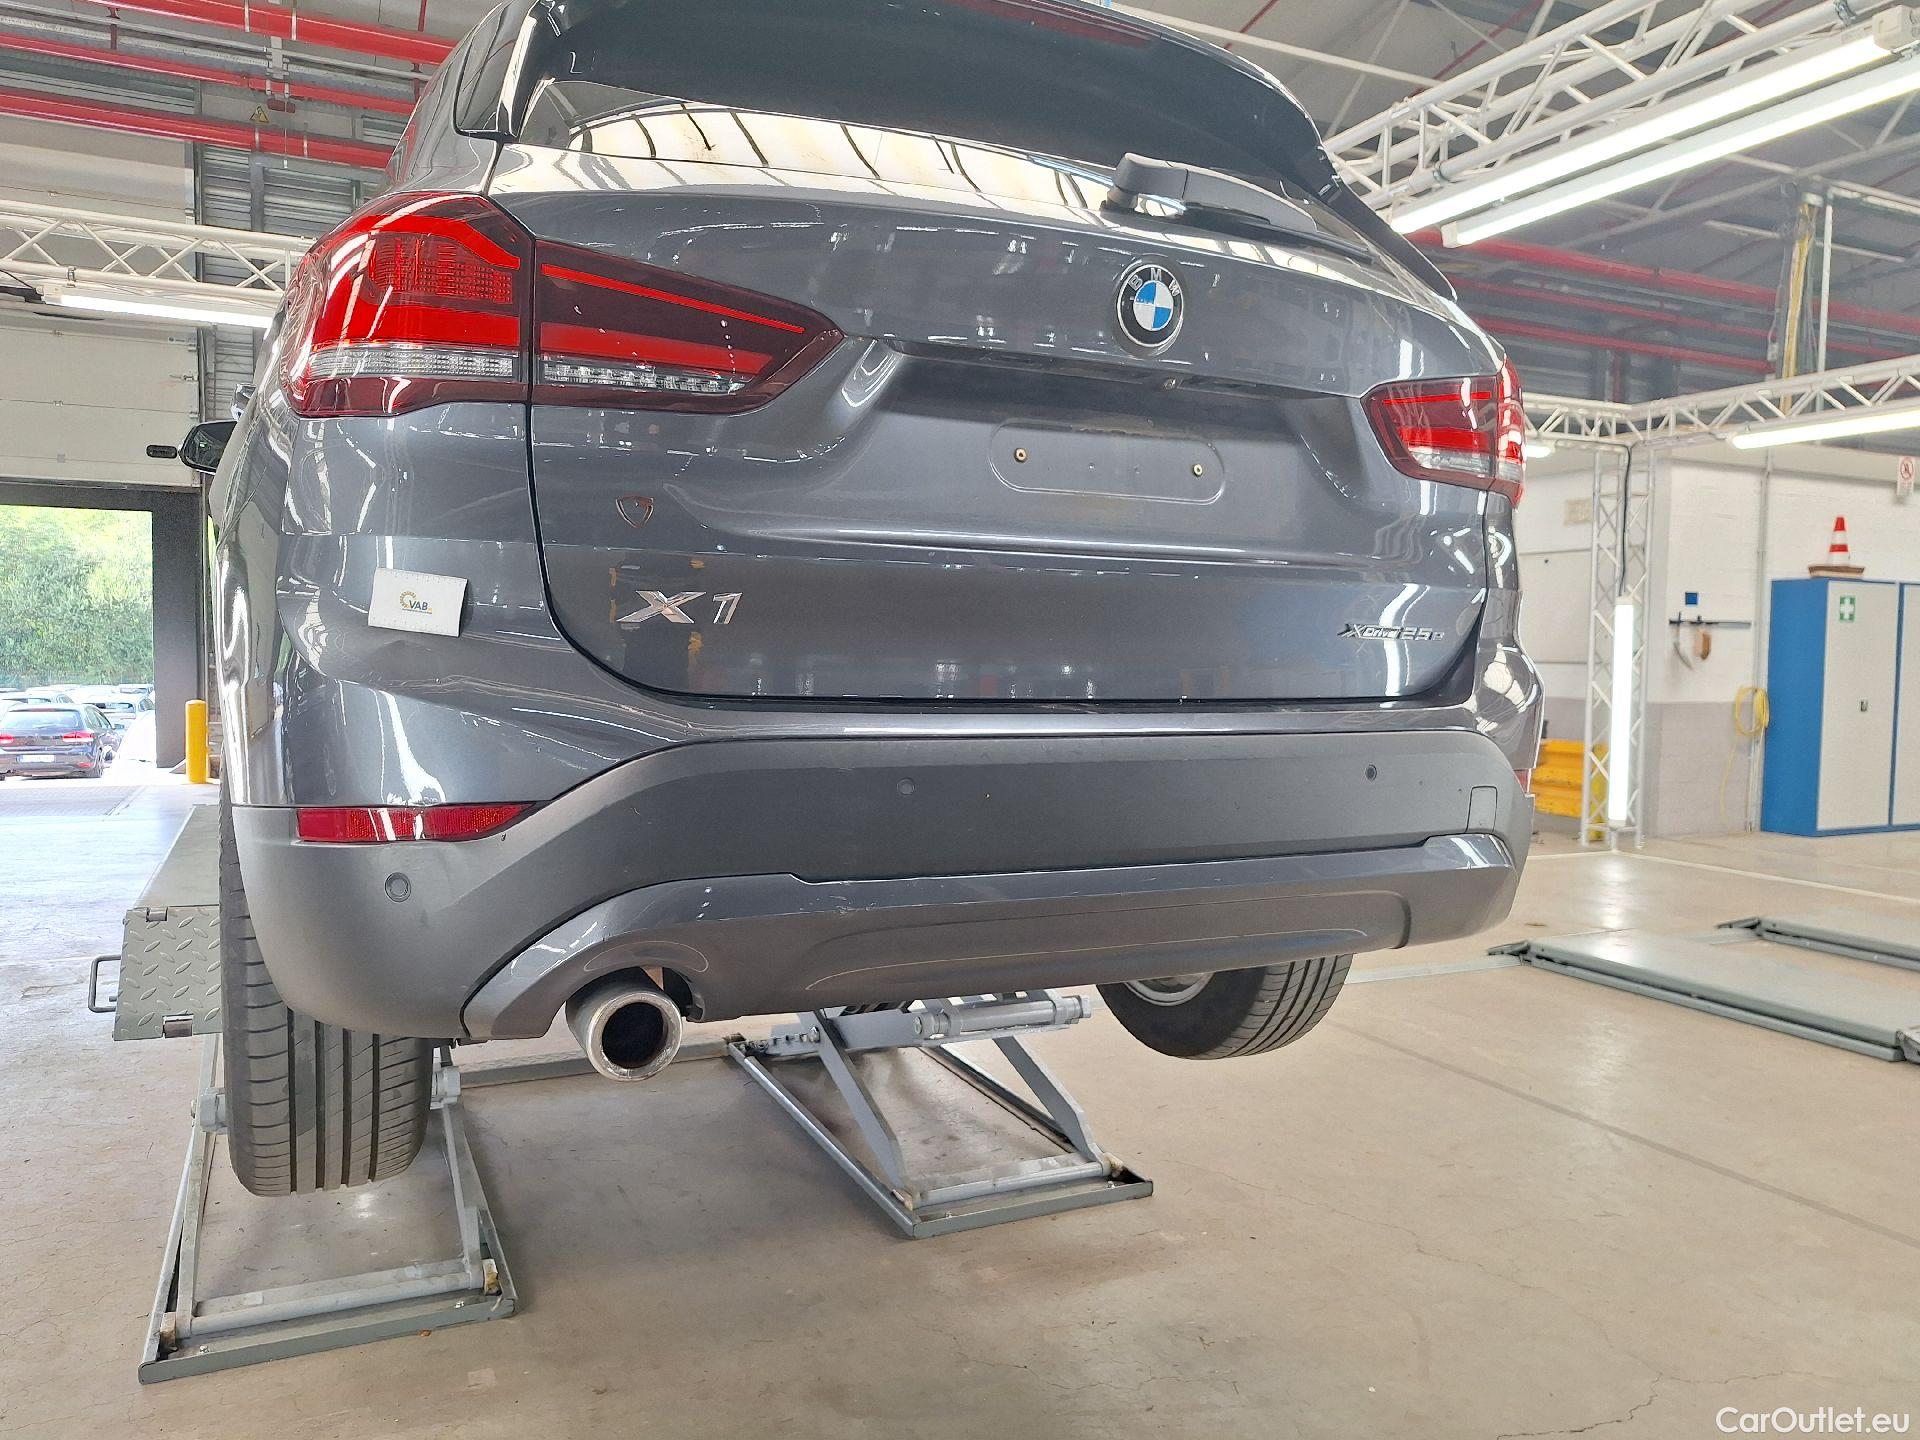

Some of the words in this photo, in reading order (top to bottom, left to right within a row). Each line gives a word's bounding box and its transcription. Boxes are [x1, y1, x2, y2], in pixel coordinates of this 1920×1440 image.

[1127, 267, 1181, 297] BMW
[408, 599, 429, 611] VAB
[616, 590, 743, 624] X1
